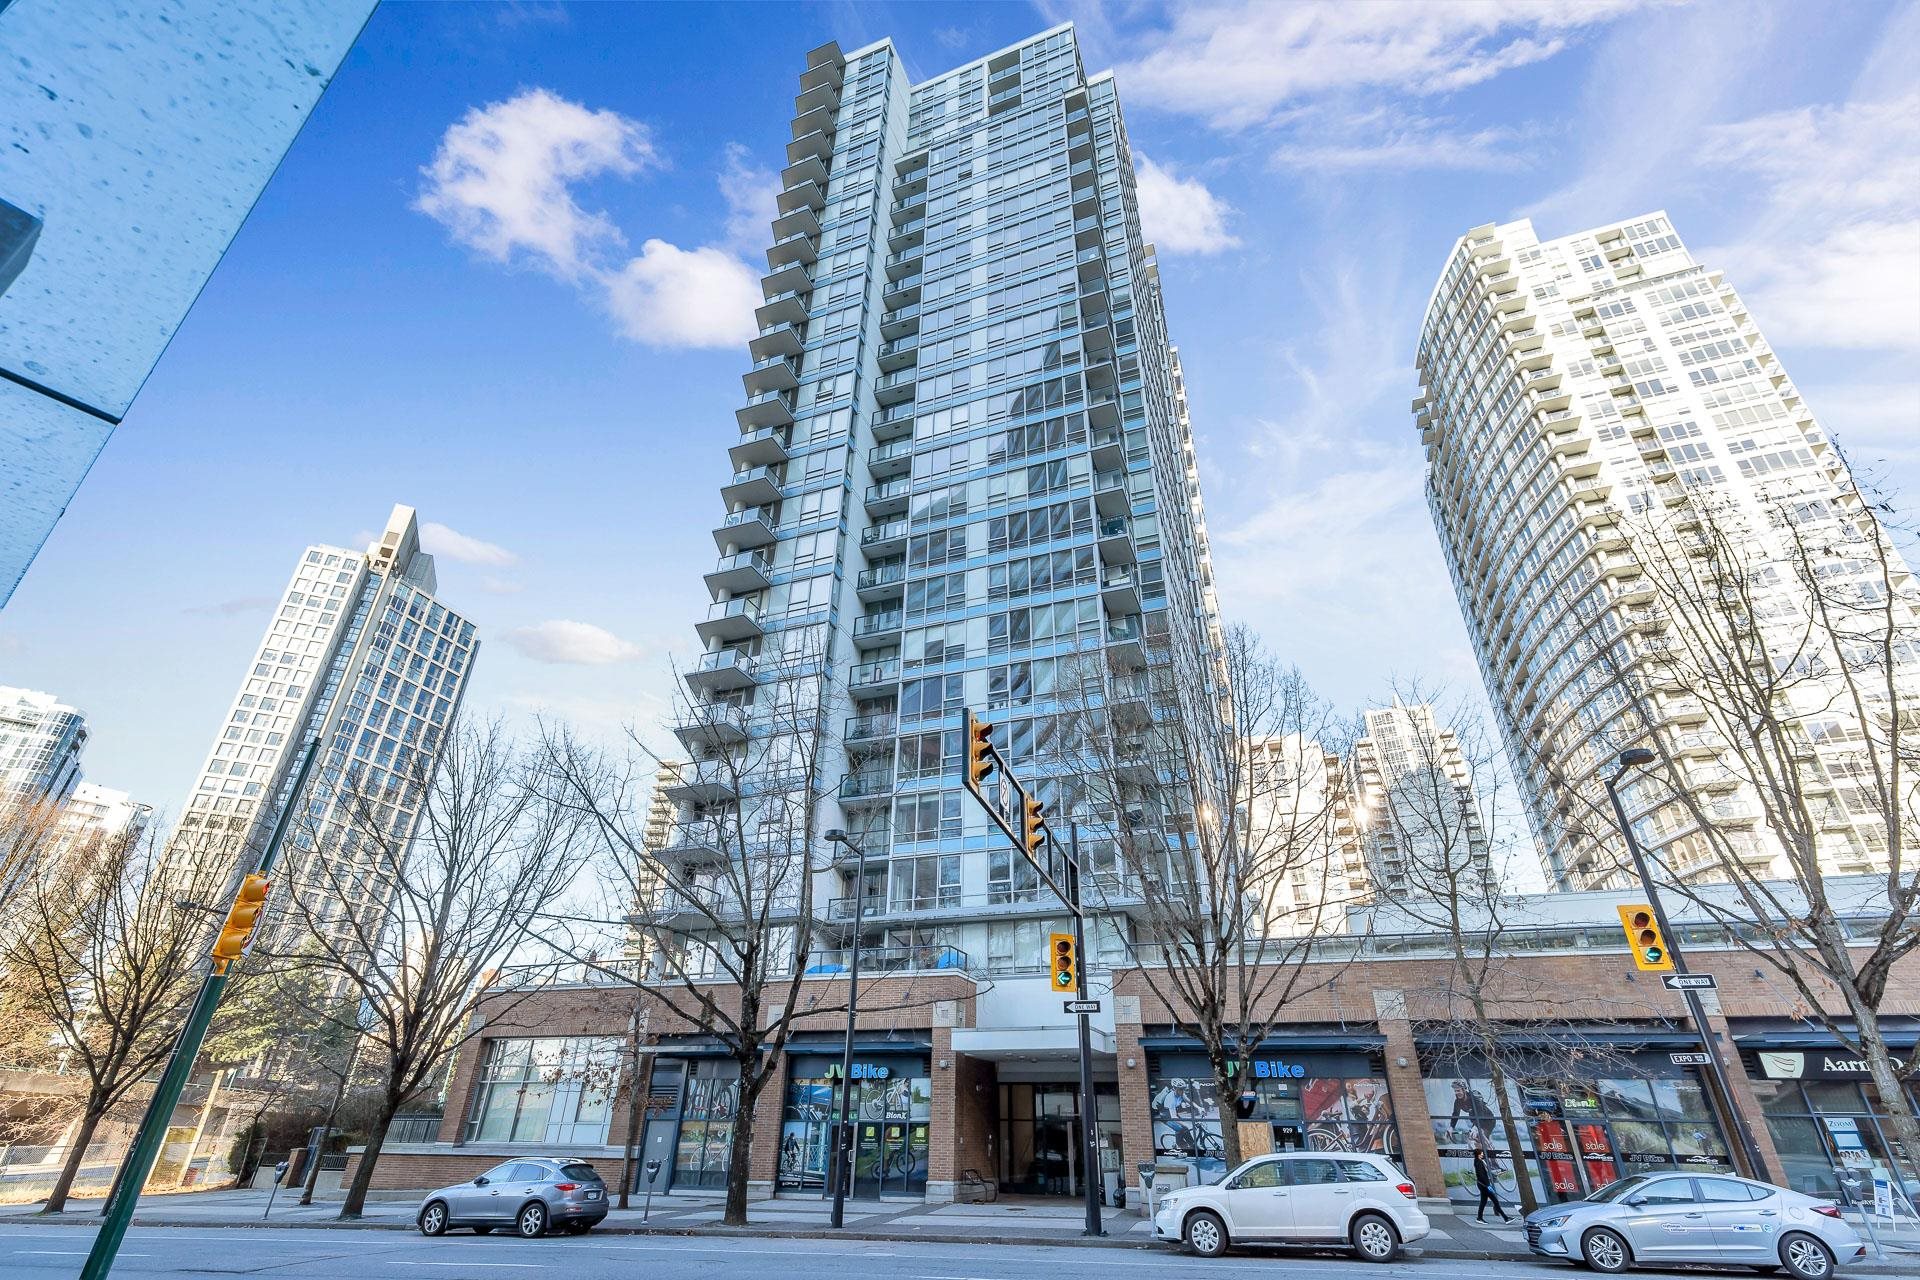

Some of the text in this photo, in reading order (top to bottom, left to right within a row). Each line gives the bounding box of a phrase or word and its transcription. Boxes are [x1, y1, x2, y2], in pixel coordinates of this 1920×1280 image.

[1673, 1055, 1693, 1063] EXPO
[851, 1063, 889, 1079] Bike
[1254, 1061, 1305, 1078] Bike
[1543, 1137, 1563, 1150] sale
[1585, 1137, 1606, 1150] sale
[1554, 1177, 1575, 1190] sale
